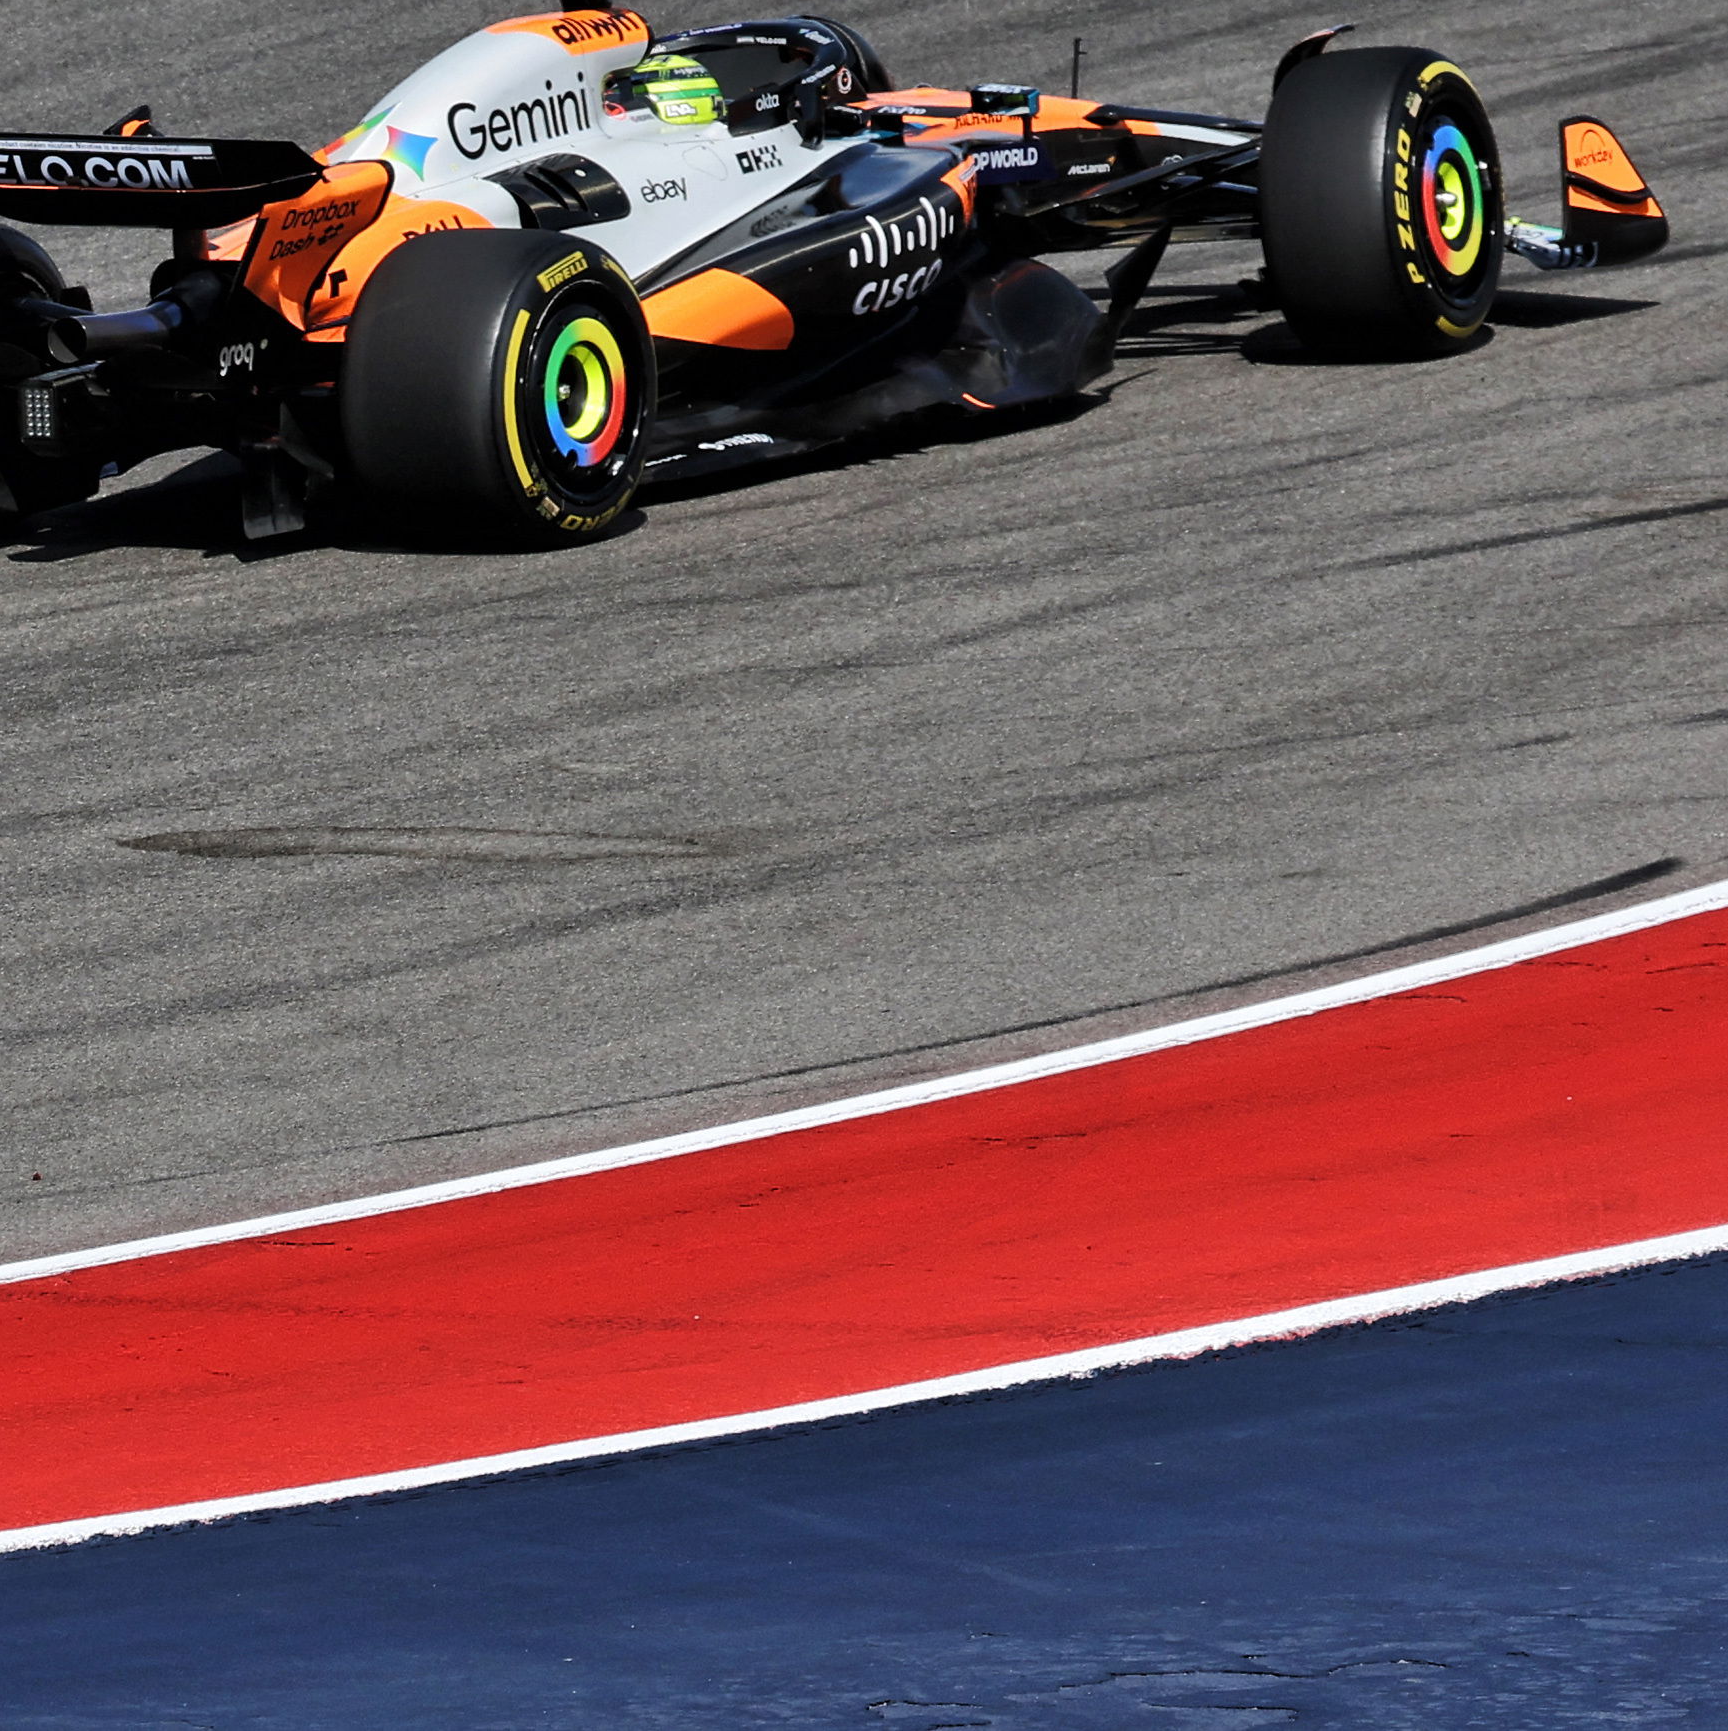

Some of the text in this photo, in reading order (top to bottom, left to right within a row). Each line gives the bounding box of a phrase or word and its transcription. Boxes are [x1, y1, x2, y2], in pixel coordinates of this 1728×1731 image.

[552, 11, 640, 46] allwyn
[447, 71, 593, 161] Gemini
[755, 93, 780, 112] okta
[991, 146, 1039, 169] WORLD
[1066, 163, 1111, 176] McLaren
[640, 177, 688, 204] ebay
[1394, 128, 1425, 284] P ZERO
[281, 198, 360, 231] Dropbox
[269, 233, 315, 261] Dash
[536, 250, 589, 294] PIRELLI
[219, 342, 255, 377] groq
